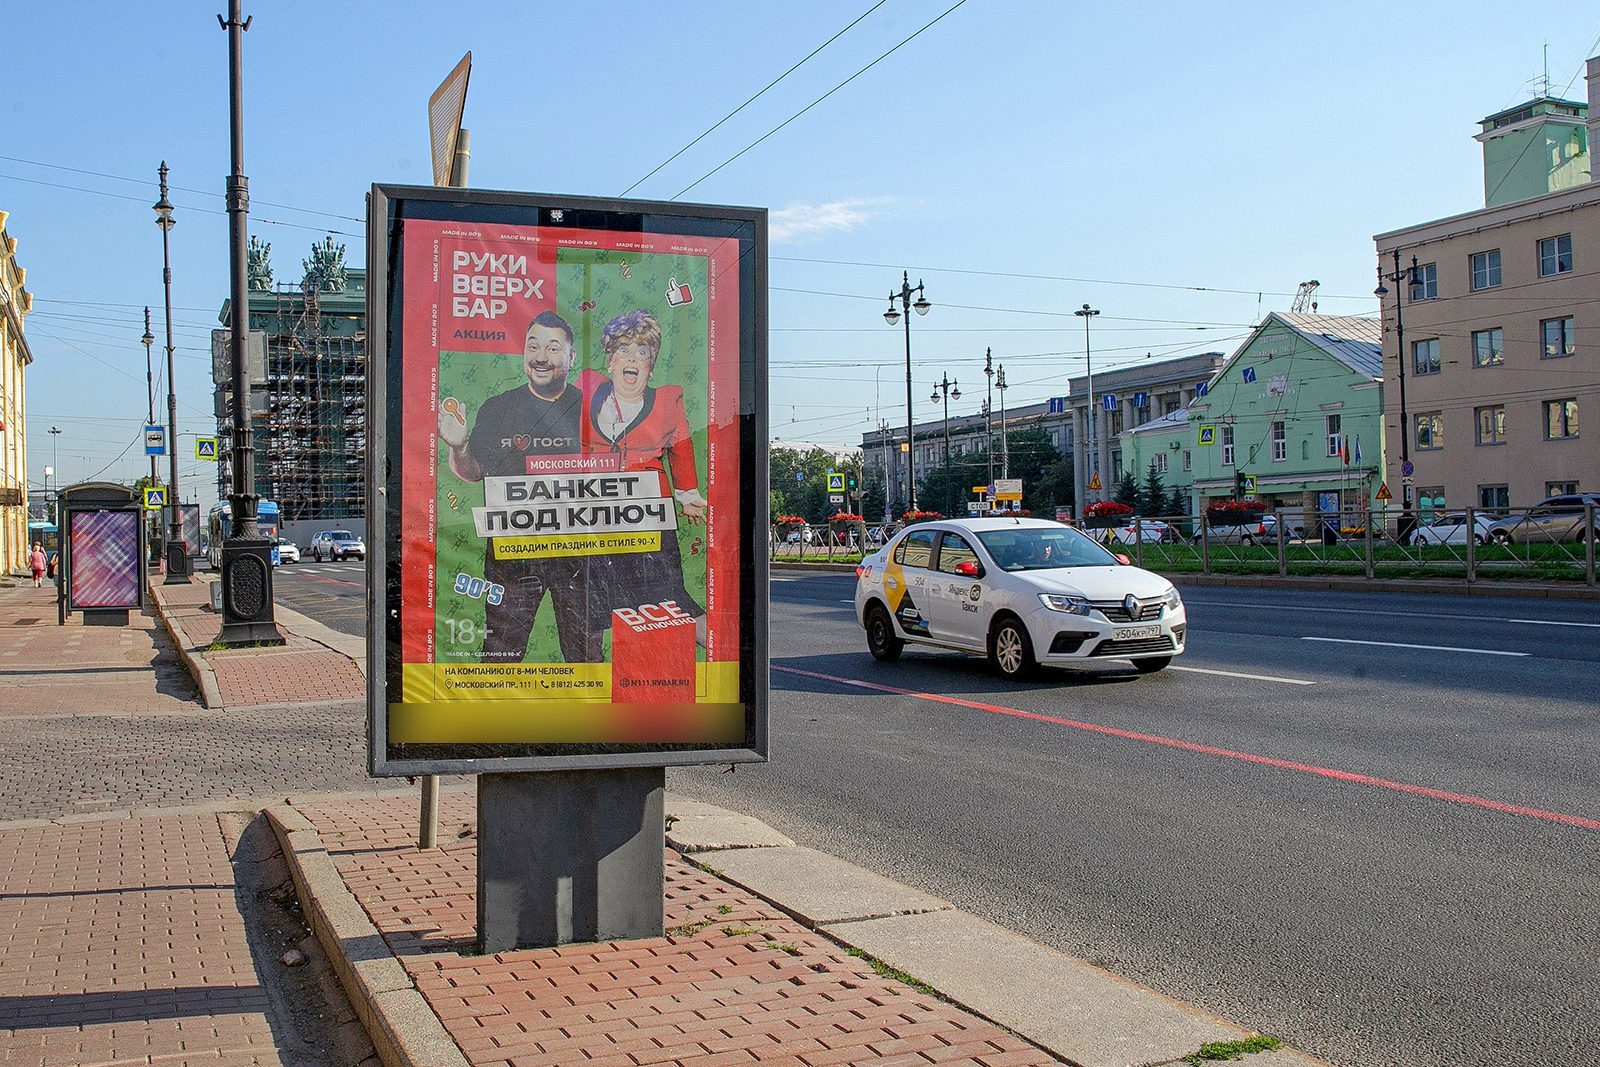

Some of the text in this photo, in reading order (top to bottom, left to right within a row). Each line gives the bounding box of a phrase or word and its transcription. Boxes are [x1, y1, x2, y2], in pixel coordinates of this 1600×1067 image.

[453, 251, 526, 275] РУКИ
[452, 274, 544, 299] ВВЕРХ
[452, 296, 508, 319] БАР
[454, 329, 505, 340] АКЦИЯ
[501, 438, 511, 448] Я
[530, 458, 614, 470] МОСКОВСКИЙ 111
[505, 477, 639, 501] БАНКЕТ
[485, 504, 666, 531] ПОД КЛЮЧ
[500, 543, 548, 554] СОЗДАДИМ
[550, 541, 598, 551] ПРАЗДНИК
[607, 539, 635, 547] СТИЛЕ
[637, 538, 656, 546] 90-Х
[454, 573, 505, 605] 90'S
[949, 584, 969, 596] Яндекс
[613, 600, 690, 625] ВСЕ
[962, 601, 978, 613] Такси
[445, 619, 493, 644] 18+
[632, 617, 696, 632] ВКЛЮЧЕНО
[455, 680, 504, 688] МОСКОВСКИЙ
